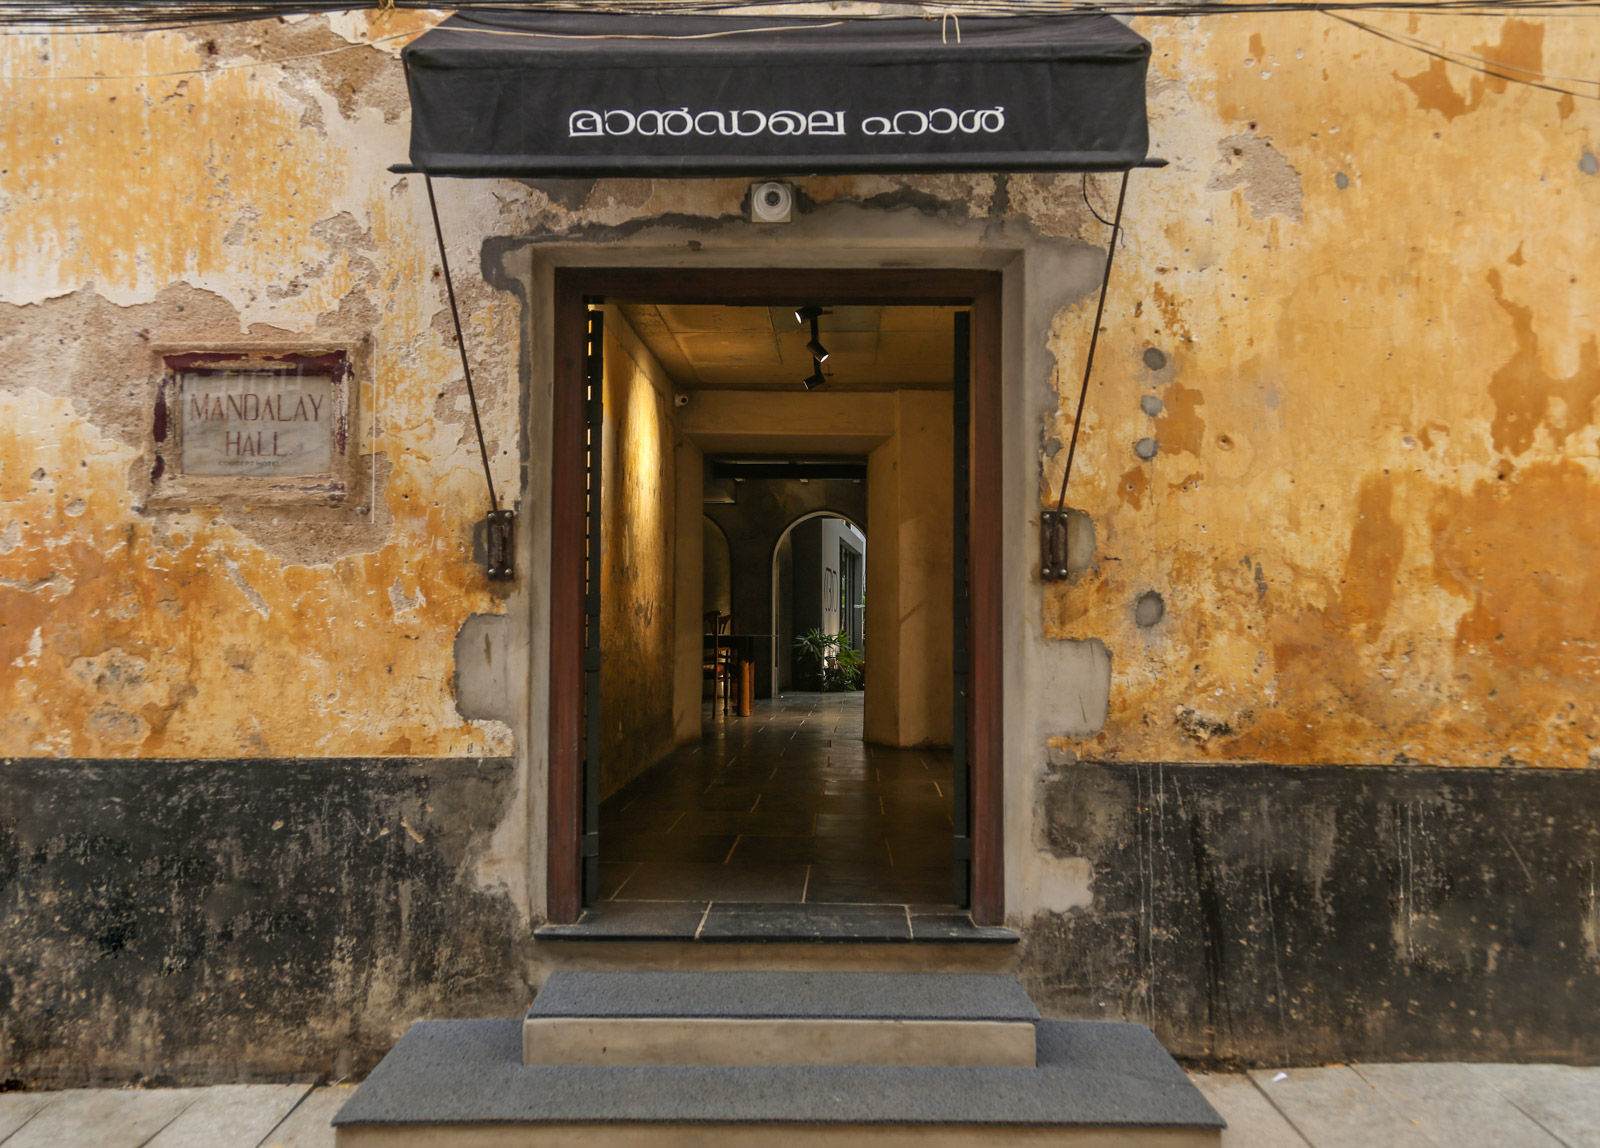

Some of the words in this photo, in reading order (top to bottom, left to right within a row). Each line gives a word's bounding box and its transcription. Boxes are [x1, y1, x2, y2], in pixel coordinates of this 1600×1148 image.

[568, 107, 847, 137] മാൻഡലെ
[861, 106, 1005, 136] ഹാൾ
[190, 393, 324, 421] MANDALAY
